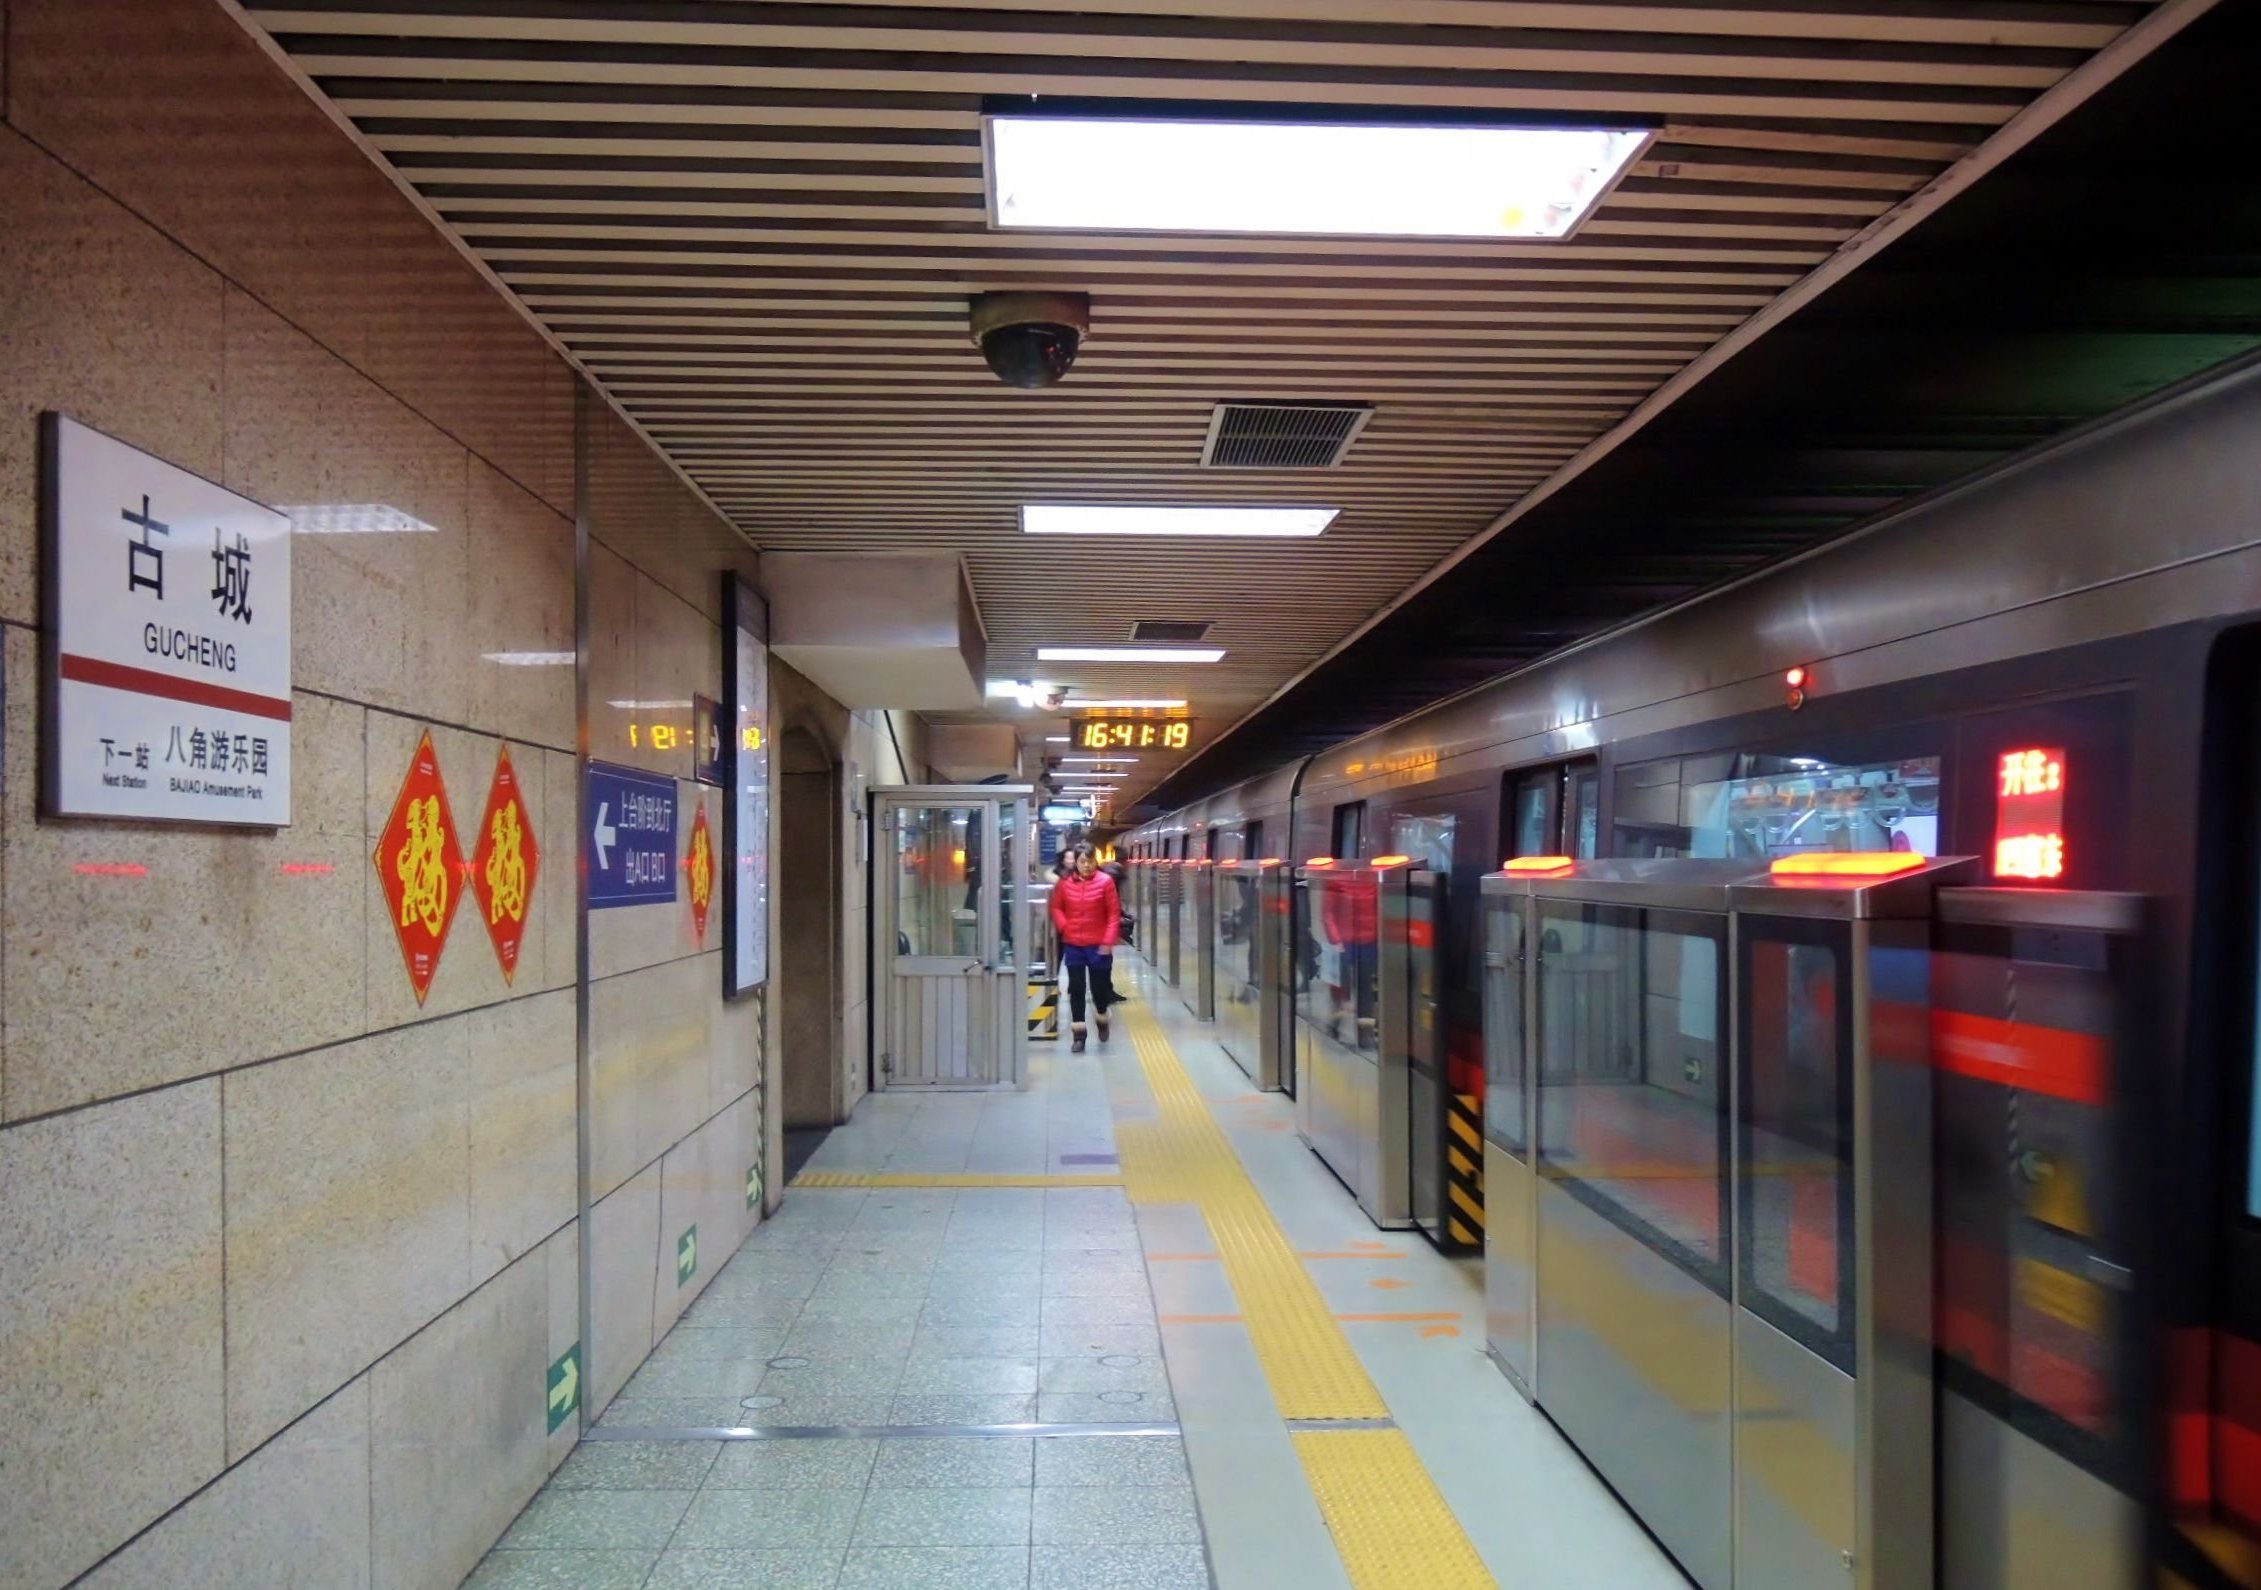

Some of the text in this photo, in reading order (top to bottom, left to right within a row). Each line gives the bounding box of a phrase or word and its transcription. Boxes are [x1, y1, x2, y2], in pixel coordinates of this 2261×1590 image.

[121, 494, 252, 625] 古城
[144, 621, 236, 672] GUCHENG
[165, 725, 268, 776] 八角游乐园
[1084, 722, 1189, 748] 16:41:19
[99, 737, 150, 770] 下一站
[102, 773, 147, 789] Next Station
[170, 777, 263, 800] BAJIAO Amusement Park
